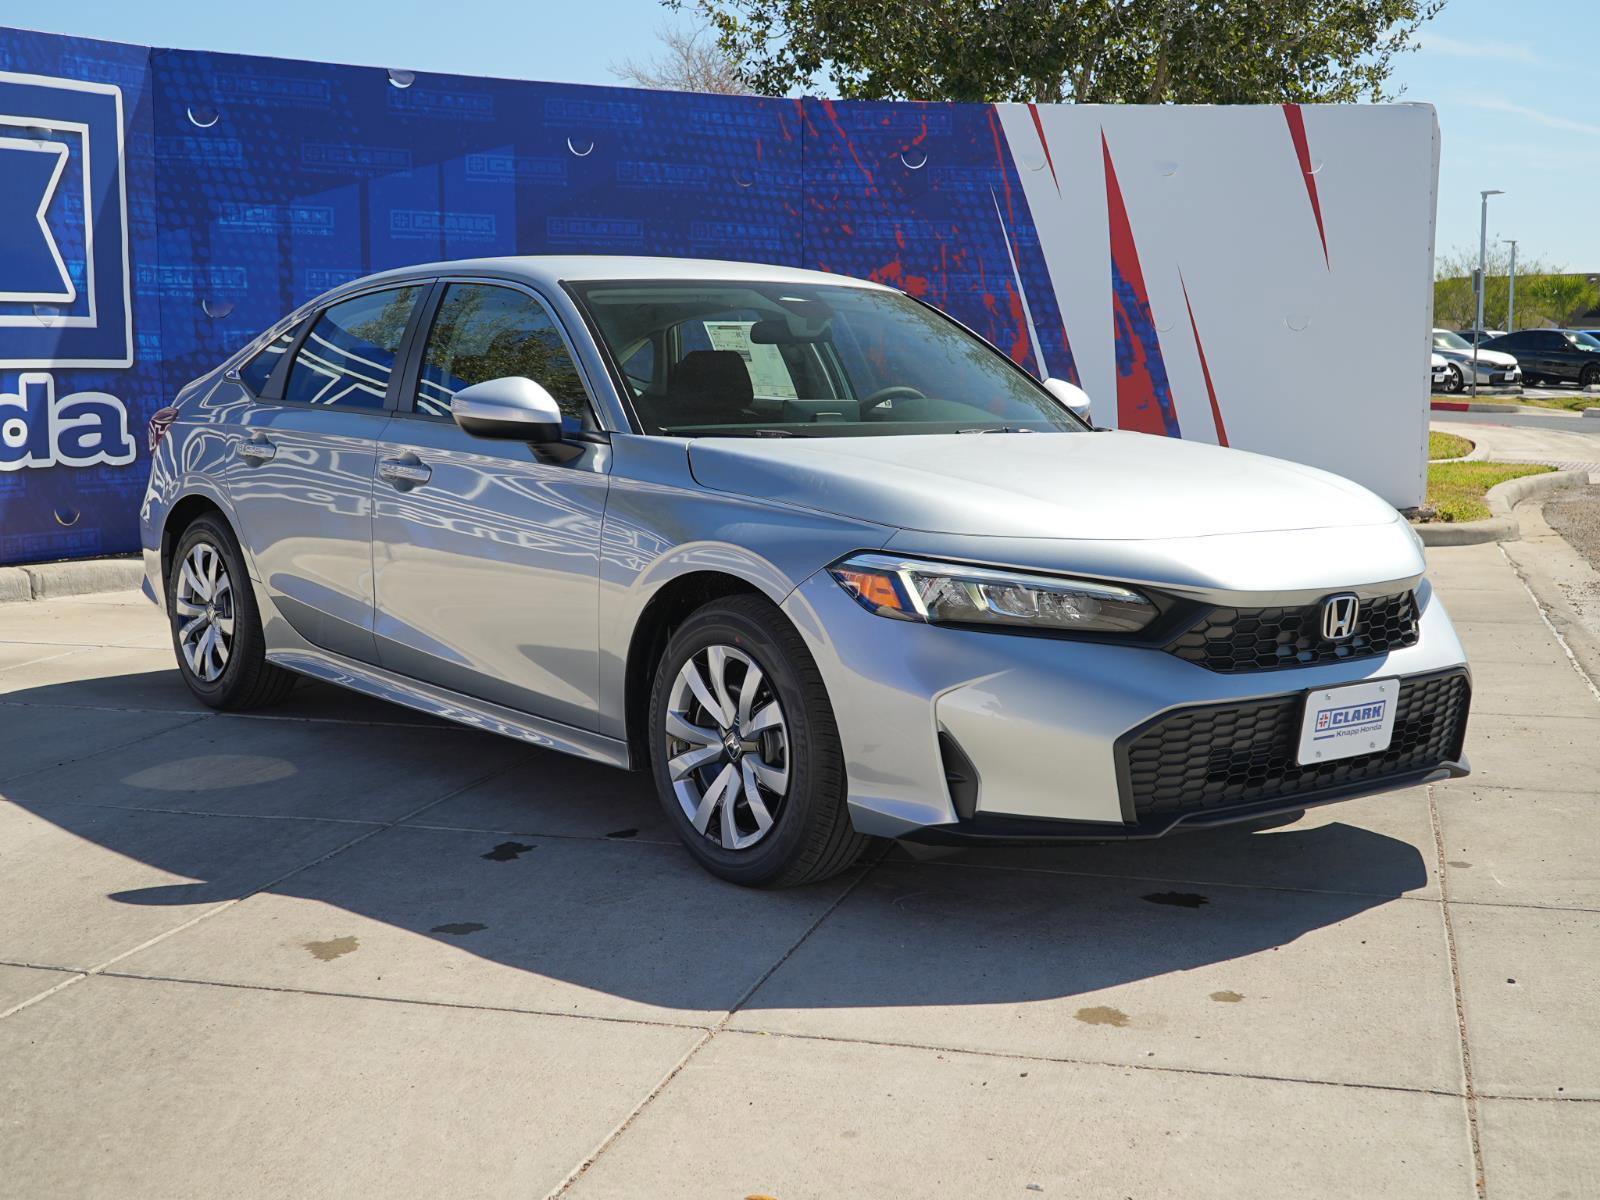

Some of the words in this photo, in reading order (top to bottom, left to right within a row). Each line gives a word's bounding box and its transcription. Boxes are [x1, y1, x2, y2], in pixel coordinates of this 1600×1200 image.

[1332, 705, 1382, 725] CLARK
[1336, 728, 1360, 737] Knapp
[1360, 722, 1382, 733] Honda
